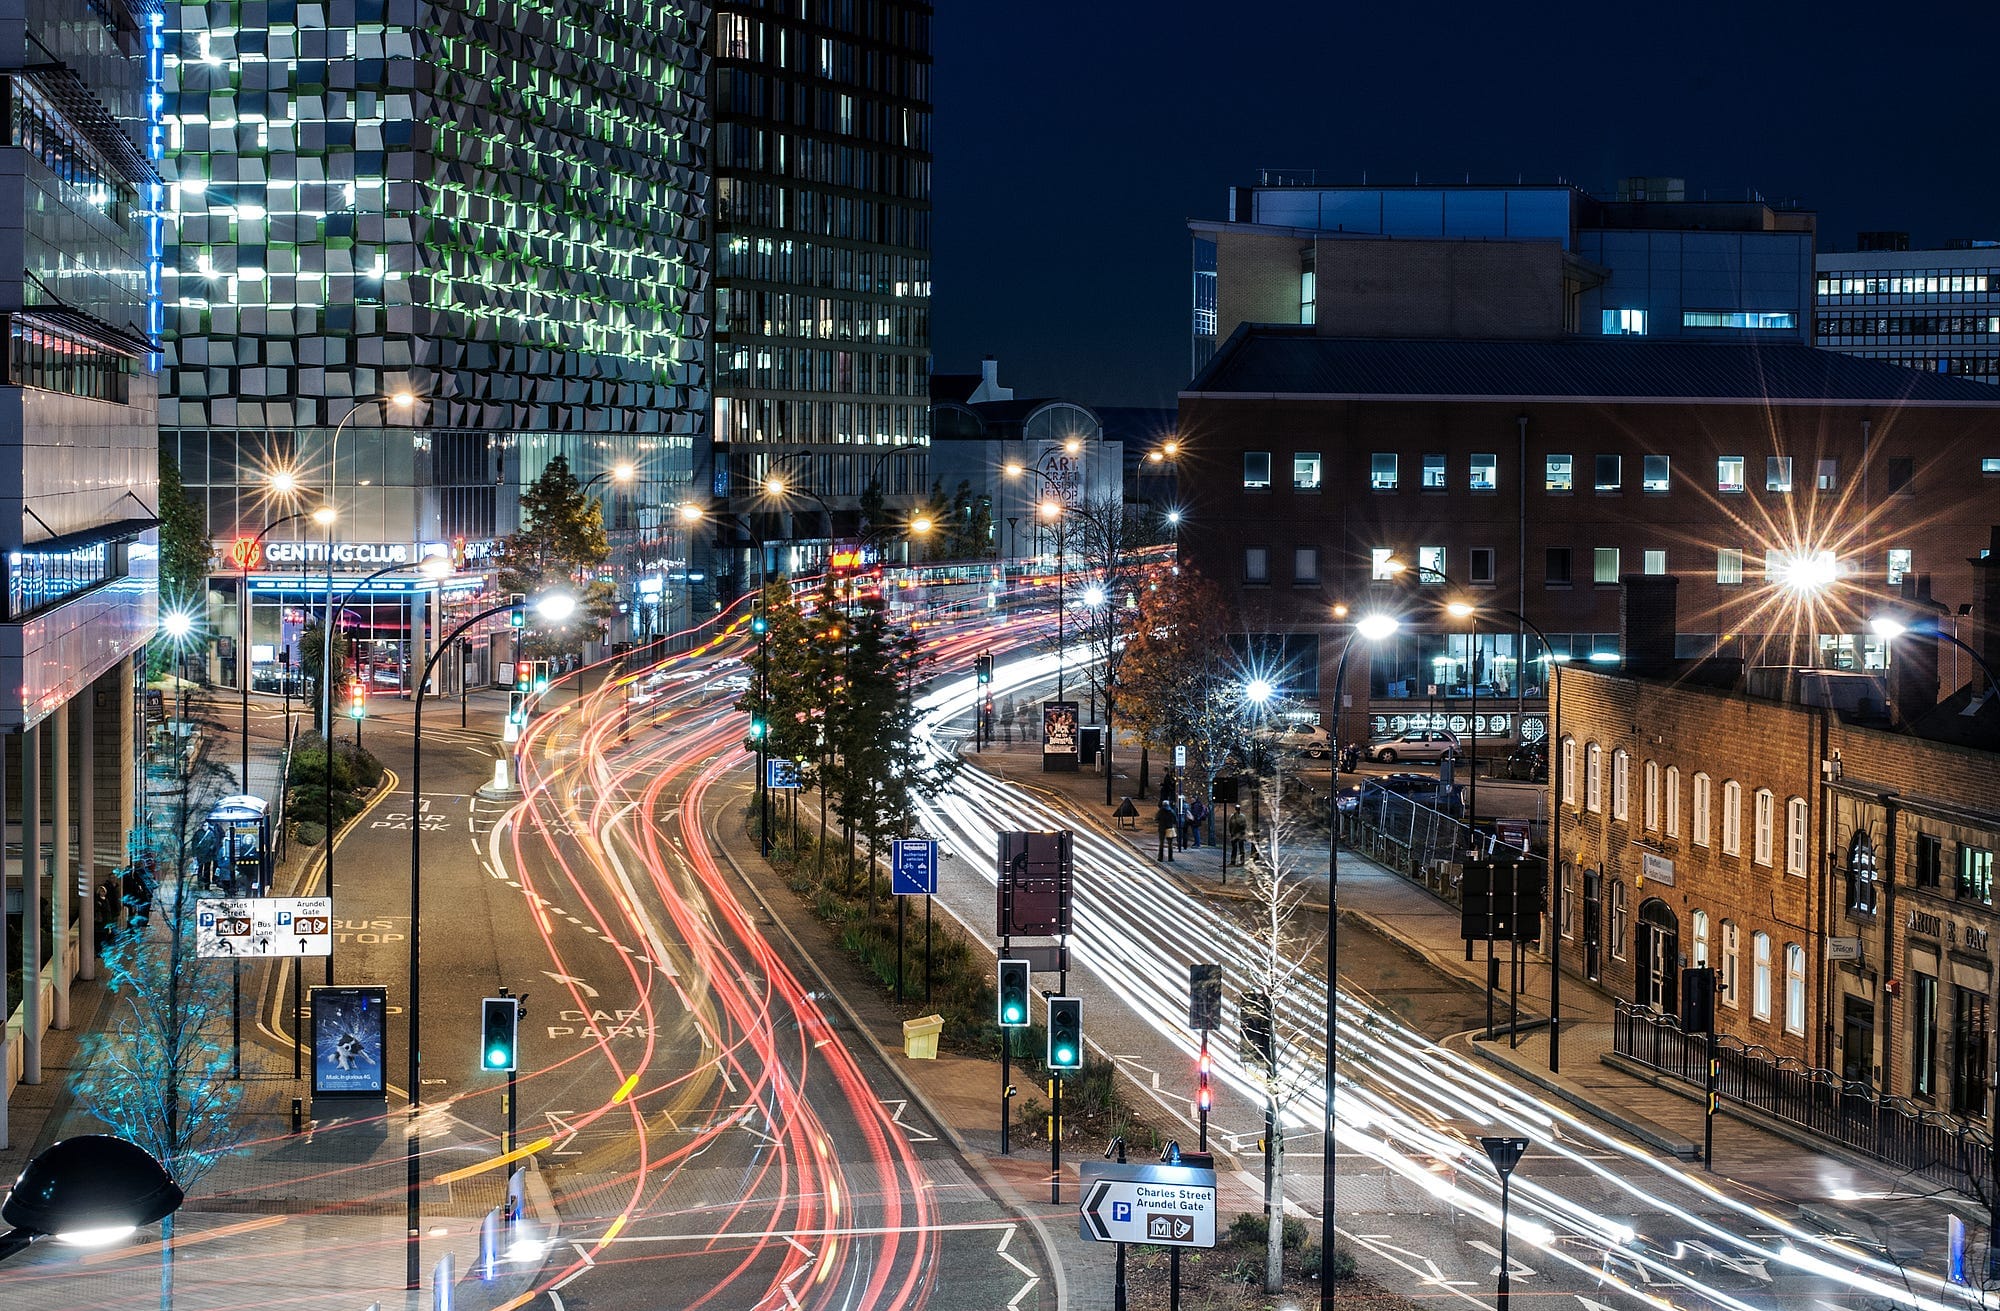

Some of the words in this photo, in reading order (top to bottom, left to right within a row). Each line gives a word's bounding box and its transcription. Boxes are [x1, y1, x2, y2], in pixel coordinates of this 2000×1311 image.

[265, 544, 357, 562] GENTING
[356, 544, 407, 562] CLUB
[386, 813, 446, 822] CAR
[370, 821, 450, 831] PARK
[296, 900, 326, 908] Arundel
[222, 909, 246, 917] Street
[332, 933, 405, 944] TOP
[560, 1009, 645, 1021] CAR
[547, 1025, 663, 1039] PARK
[1136, 1187, 1175, 1198] Charles
[1179, 1189, 1212, 1201] Street
[1136, 1198, 1177, 1210] Arundel
[1179, 1200, 1204, 1211] Gate
